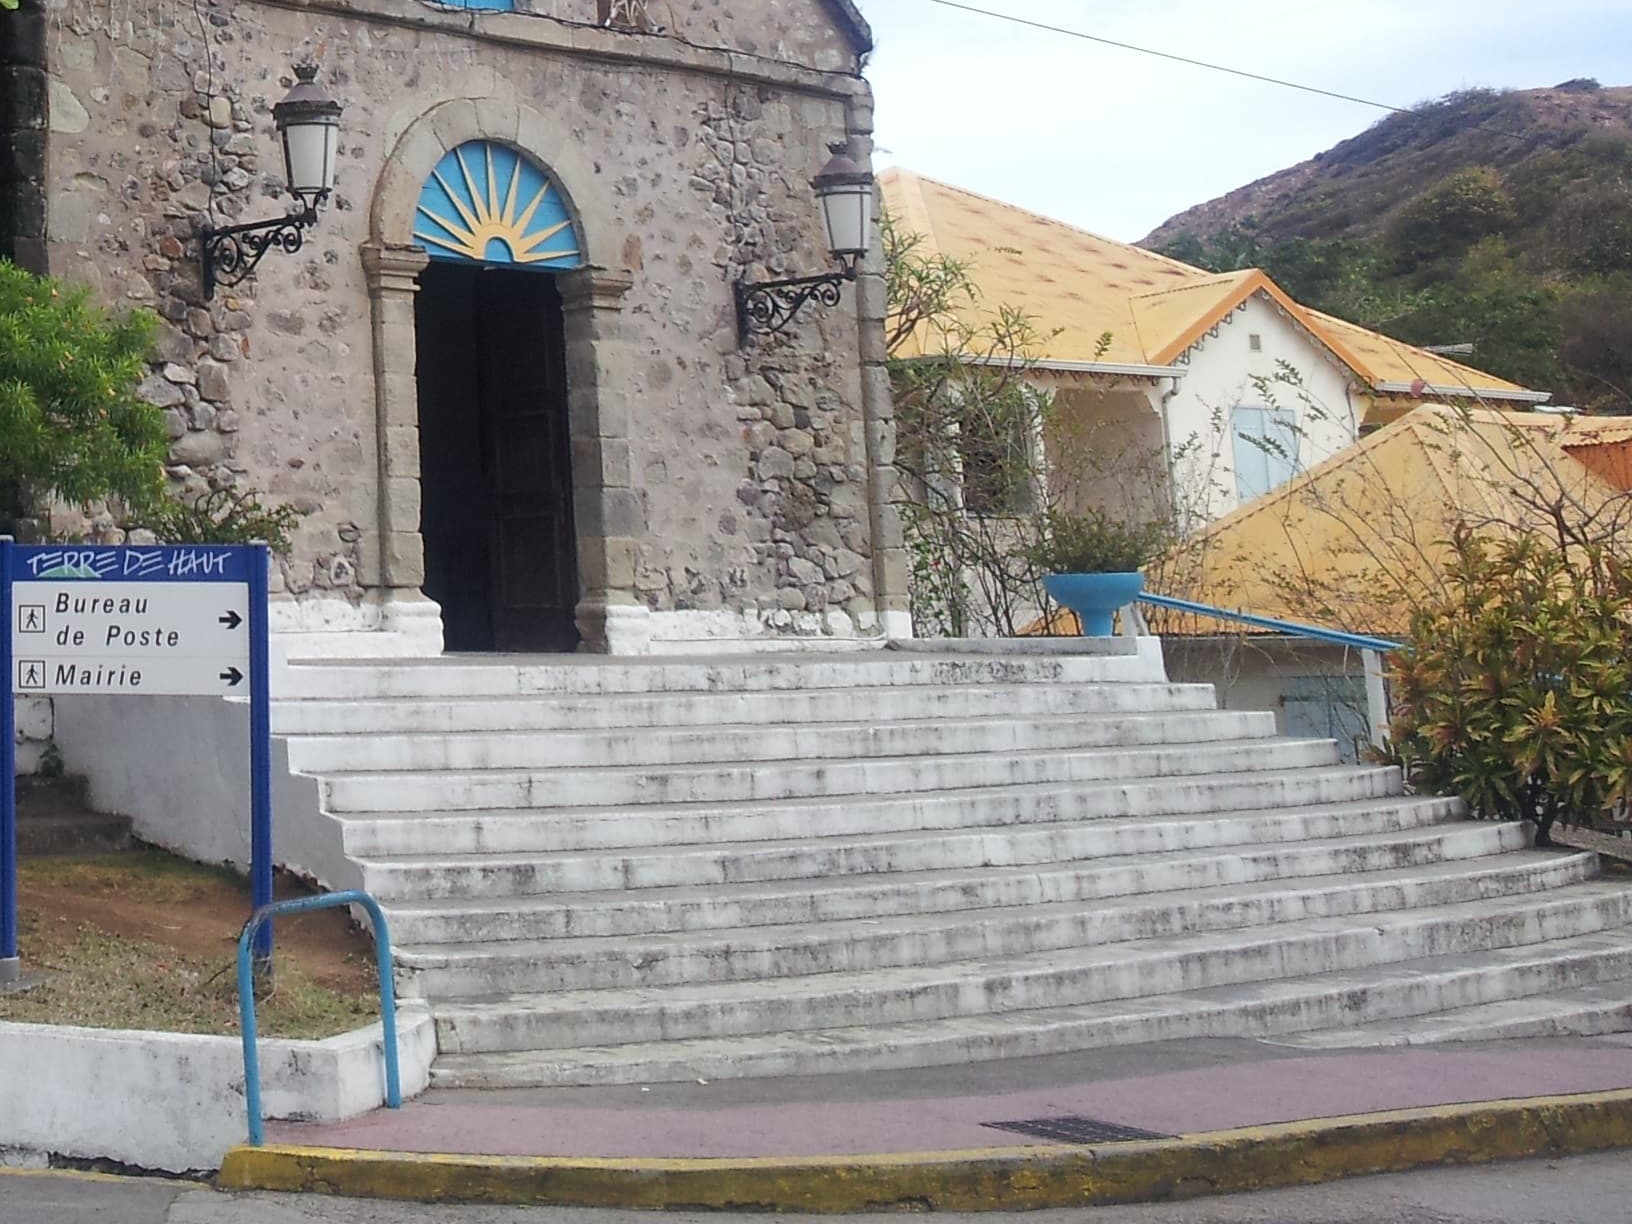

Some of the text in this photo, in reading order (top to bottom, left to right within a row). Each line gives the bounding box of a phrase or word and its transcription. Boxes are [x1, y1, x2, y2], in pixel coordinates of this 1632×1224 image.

[27, 549, 232, 577] TERRE DE HAUT
[55, 592, 148, 614] Bureau
[56, 625, 180, 647] de Poste
[55, 664, 142, 686] Mairie
